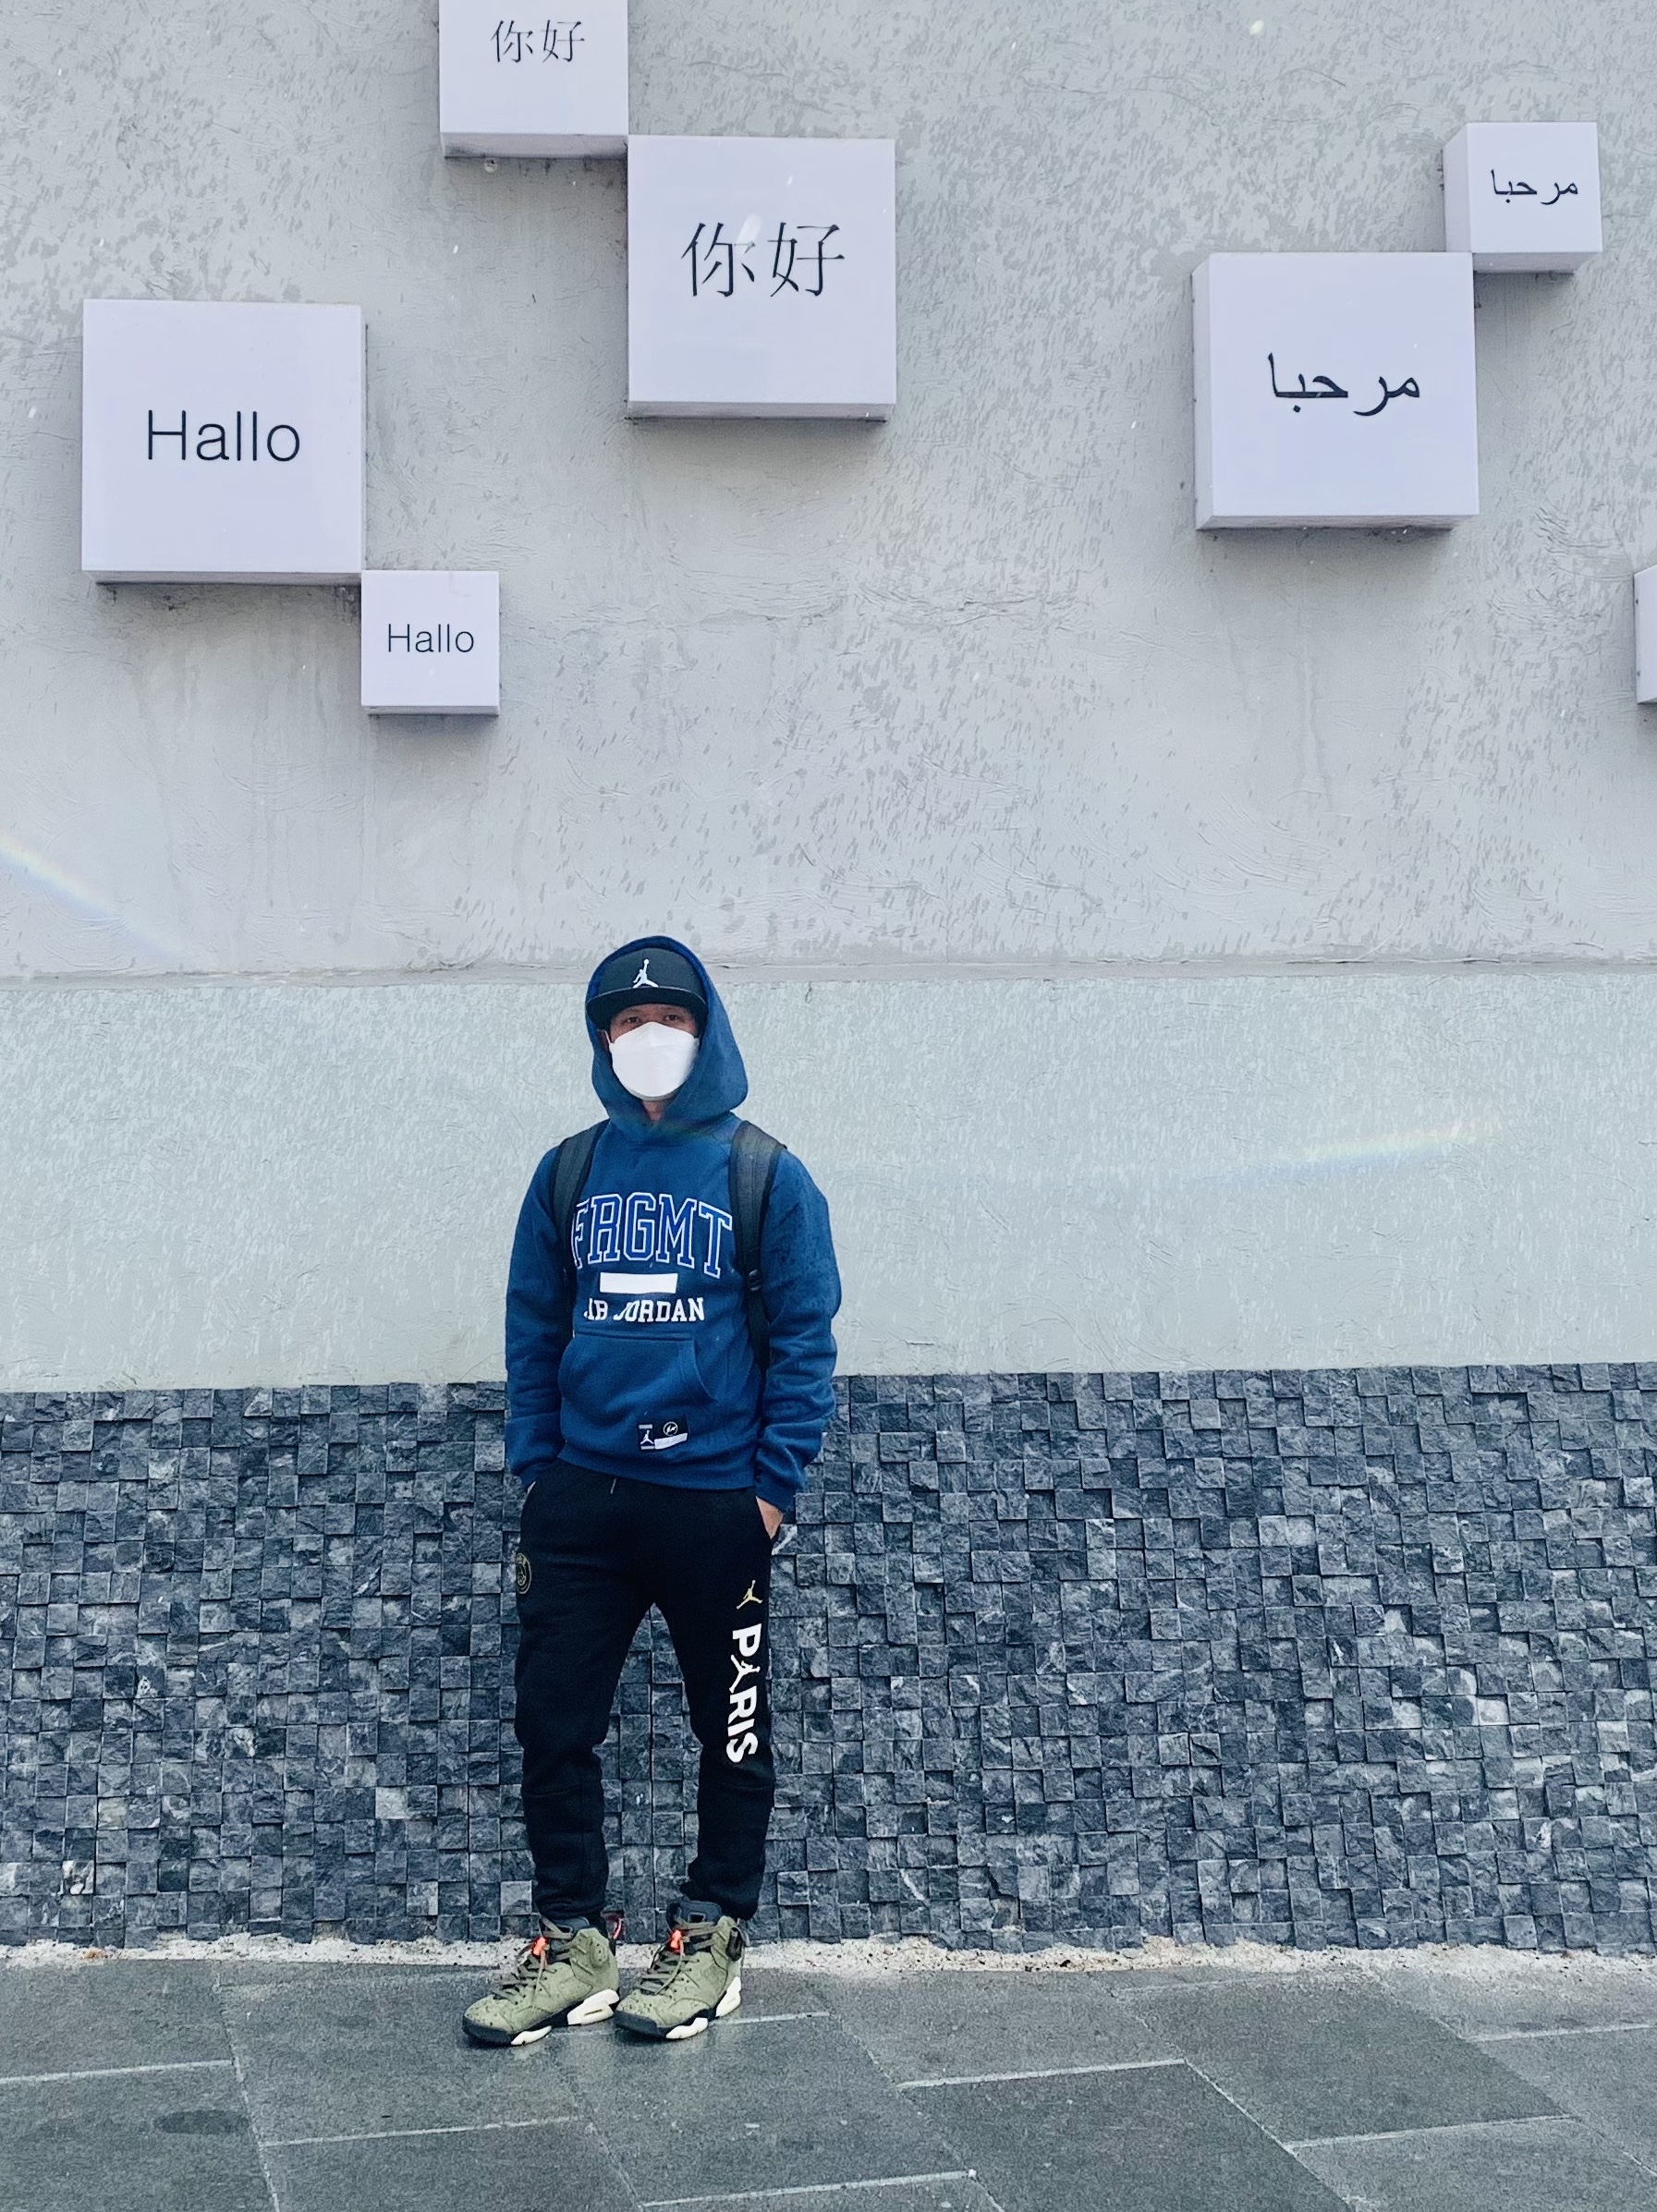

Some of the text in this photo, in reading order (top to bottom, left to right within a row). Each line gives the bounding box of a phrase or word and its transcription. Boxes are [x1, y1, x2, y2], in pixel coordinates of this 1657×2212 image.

[490, 19, 586, 65] 你好
[1490, 168, 1579, 206] مرحبا
[680, 221, 847, 298] 你好
[1267, 352, 1421, 418] مرحبا
[147, 409, 301, 463] Hallo
[387, 623, 476, 653] Hallo
[570, 1191, 733, 1280] FRGMT
[613, 1296, 705, 1323] JORDAN
